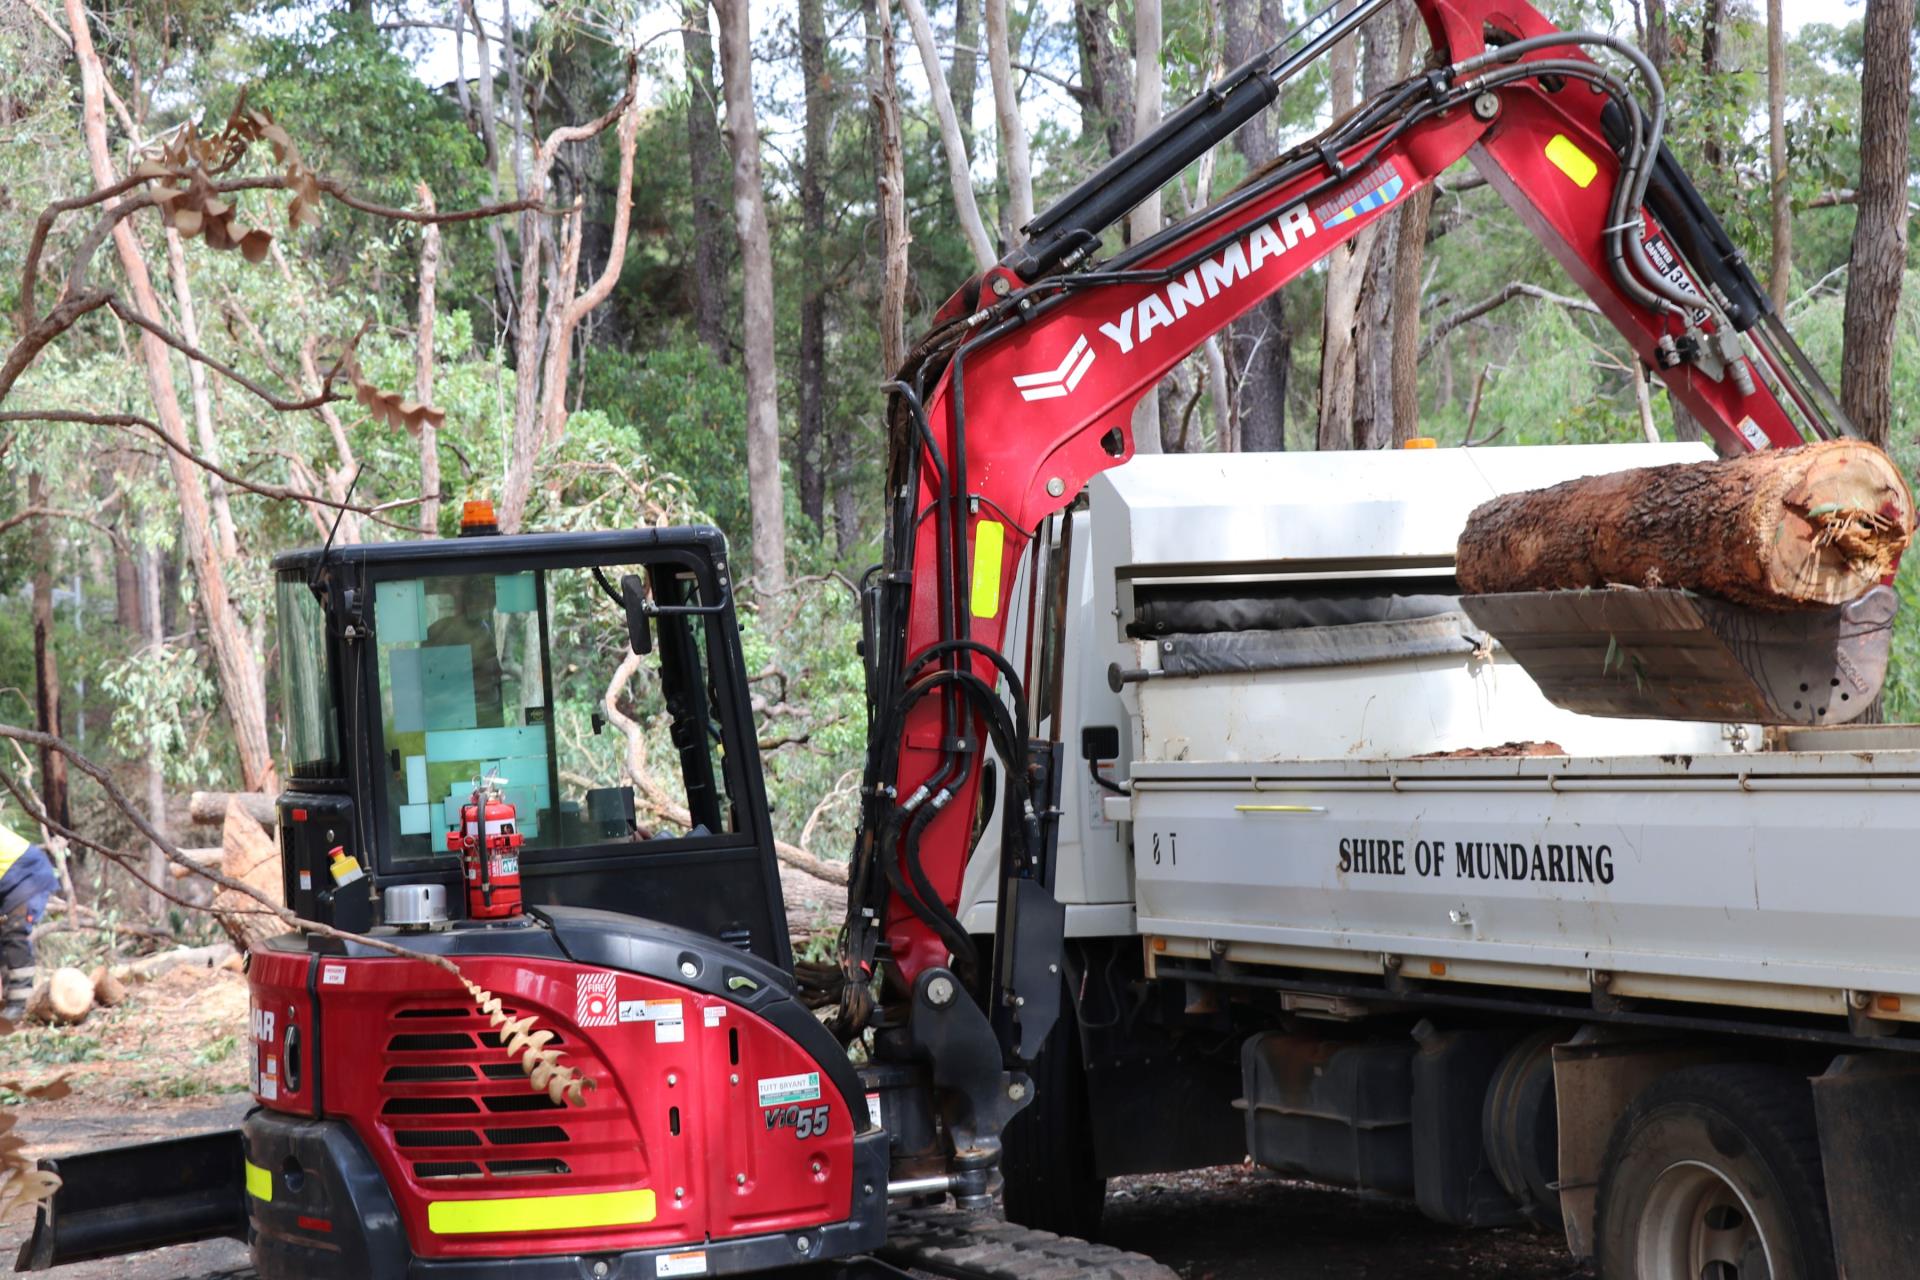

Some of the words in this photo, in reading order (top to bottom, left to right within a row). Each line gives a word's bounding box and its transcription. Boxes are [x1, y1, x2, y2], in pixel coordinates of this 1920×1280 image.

[1645, 241, 1670, 275] CAPACITY
[1655, 240, 1673, 264] RATED
[1099, 203, 1317, 354] YANMAR
[1339, 838, 1406, 875] SHIRE
[1415, 840, 1445, 877] OF
[1455, 842, 1614, 884] MUNDARING
[588, 983, 606, 992] FIRE
[760, 1083, 777, 1092] TUTT
[779, 1079, 806, 1090] BRYANT
